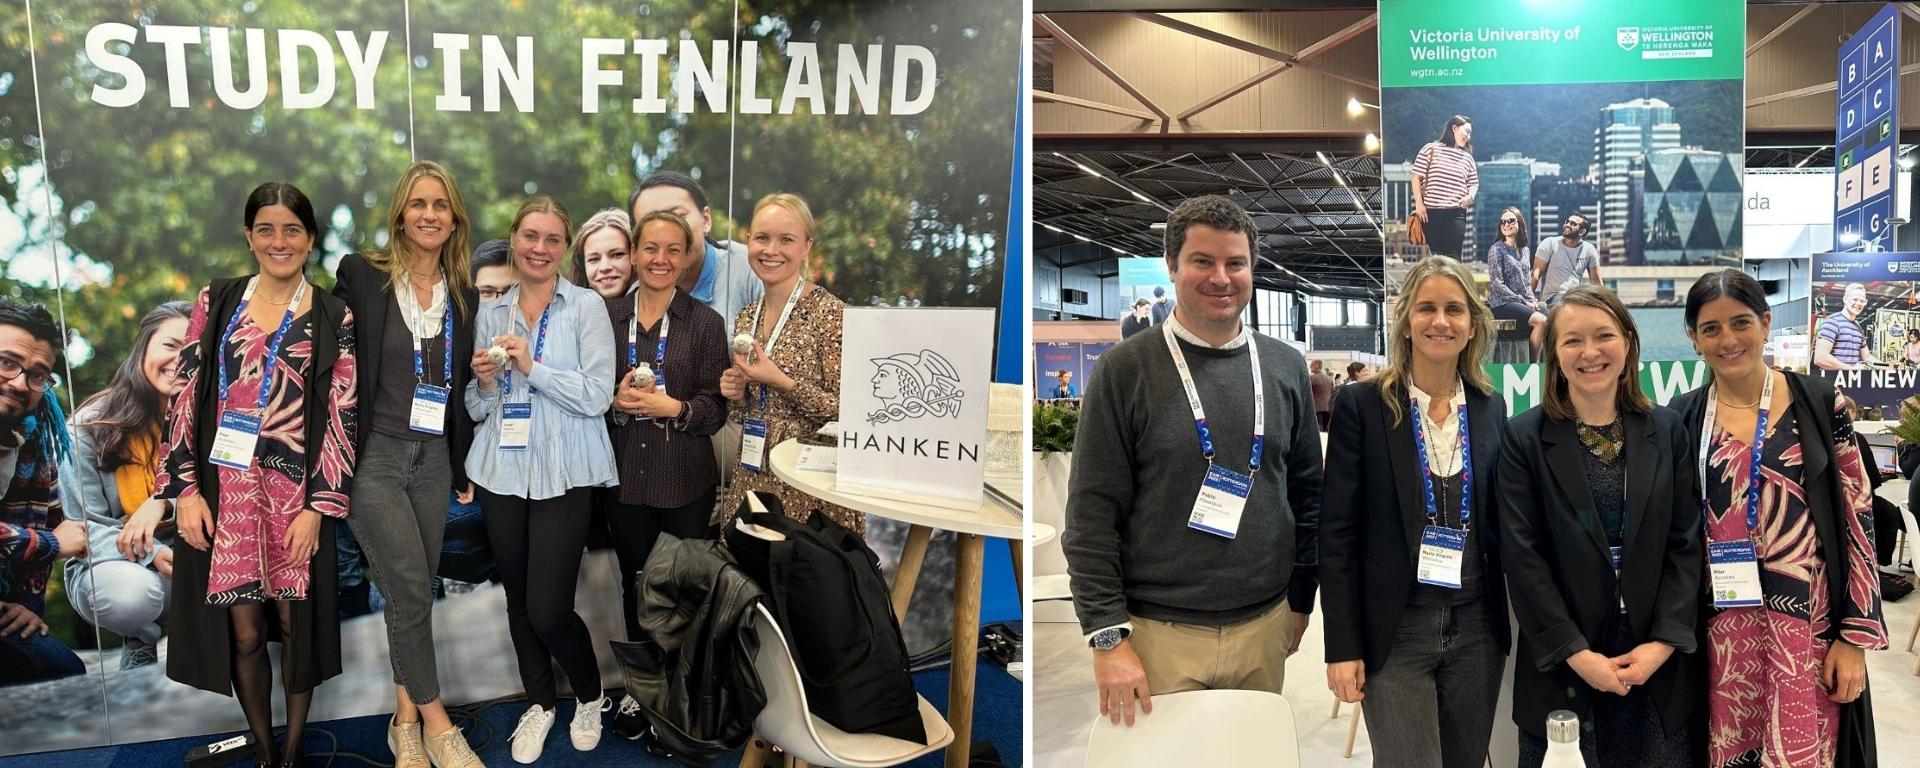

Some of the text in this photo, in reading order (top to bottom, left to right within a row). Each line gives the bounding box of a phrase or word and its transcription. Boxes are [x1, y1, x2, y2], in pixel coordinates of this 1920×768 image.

[1409, 25, 1580, 43] Victoria University of
[1642, 31, 1713, 42] WELLINGTON
[1410, 46, 1497, 62] Wellington
[1874, 41, 1884, 64] A
[85, 22, 937, 115] STUDY IN FINLAND
[1410, 68, 1464, 78] wgtn.ac.nz
[1848, 63, 1856, 83] B
[1873, 88, 1882, 109] C
[1847, 109, 1855, 129] D
[1872, 165, 1880, 185] E
[1846, 179, 1852, 198] F
[1870, 213, 1879, 233] G
[1834, 261, 1864, 269] University
[1834, 370, 1917, 388] AM NEW
[843, 430, 978, 462] HANKEN
